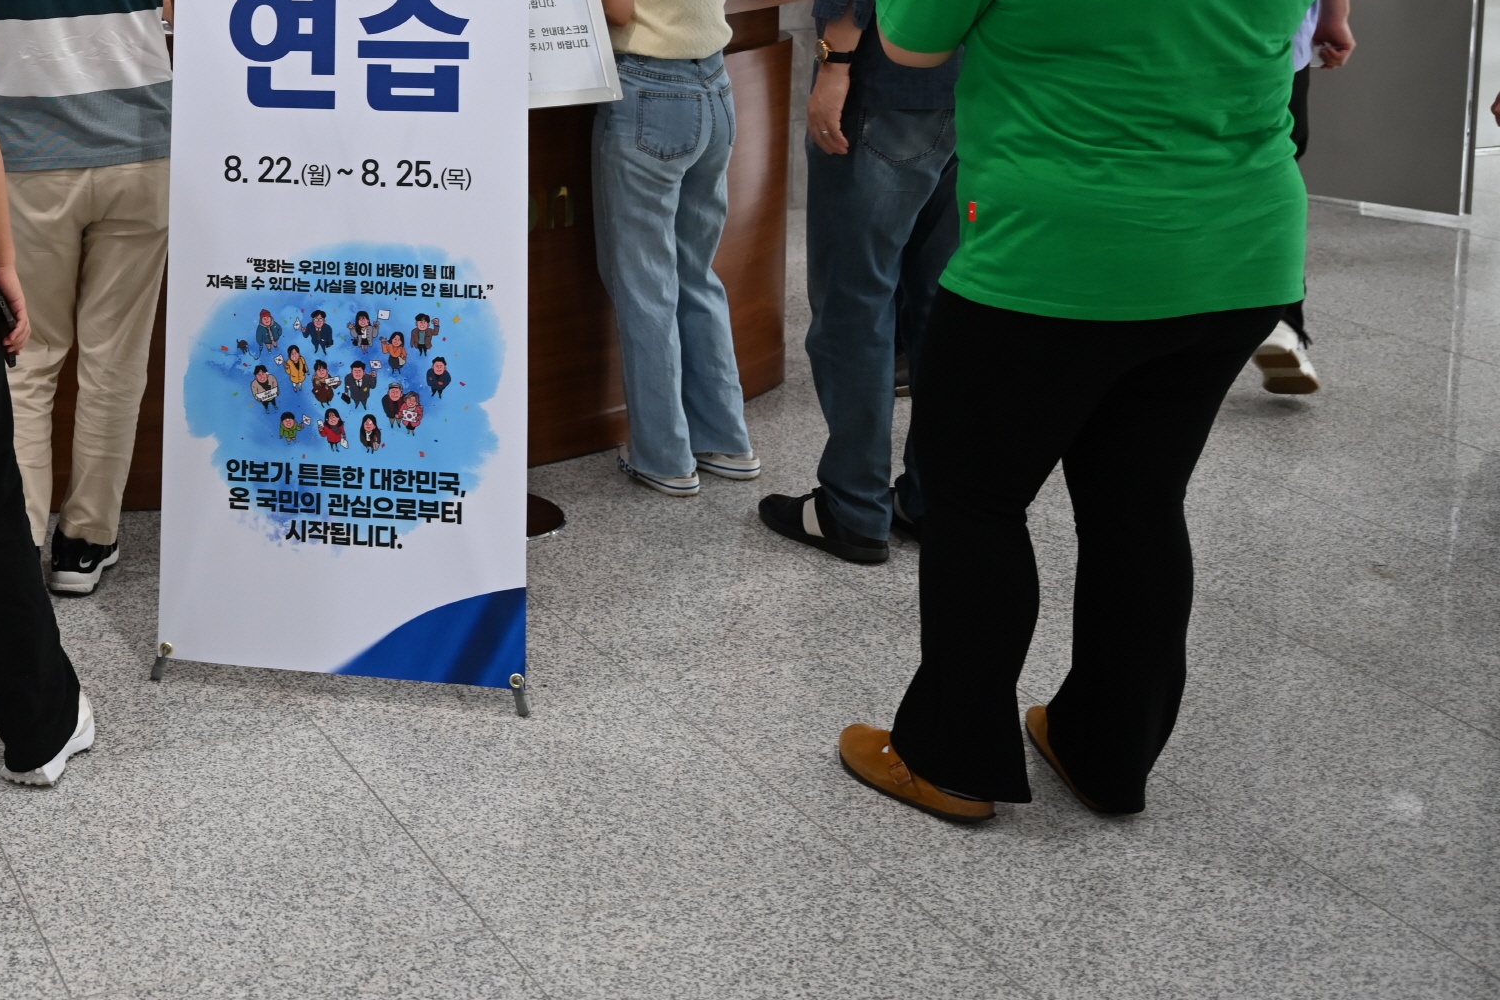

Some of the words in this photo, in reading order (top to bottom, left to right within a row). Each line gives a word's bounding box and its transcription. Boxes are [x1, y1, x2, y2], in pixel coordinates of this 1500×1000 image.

[541, 24, 589, 37] 안내데스크의
[298, 260, 341, 276] 우리의
[344, 261, 372, 277] 힘이
[376, 263, 419, 279] 바탕이
[422, 264, 437, 280] 될
[440, 265, 456, 281] 때
[206, 274, 248, 290] 지속될
[251, 276, 266, 291] 수
[268, 276, 311, 293] 있다는
[313, 278, 356, 295] 사실을
[360, 280, 418, 298] 잊어서는
[420, 282, 436, 298] 안
[226, 459, 293, 485] 안보가
[297, 463, 365, 489] 튼튼한
[370, 468, 467, 498] 대한민국,
[228, 487, 250, 510] 온
[256, 488, 321, 515] 국민의
[327, 493, 463, 525] 관심으로부터
[285, 519, 403, 550] 시작됩니다.
